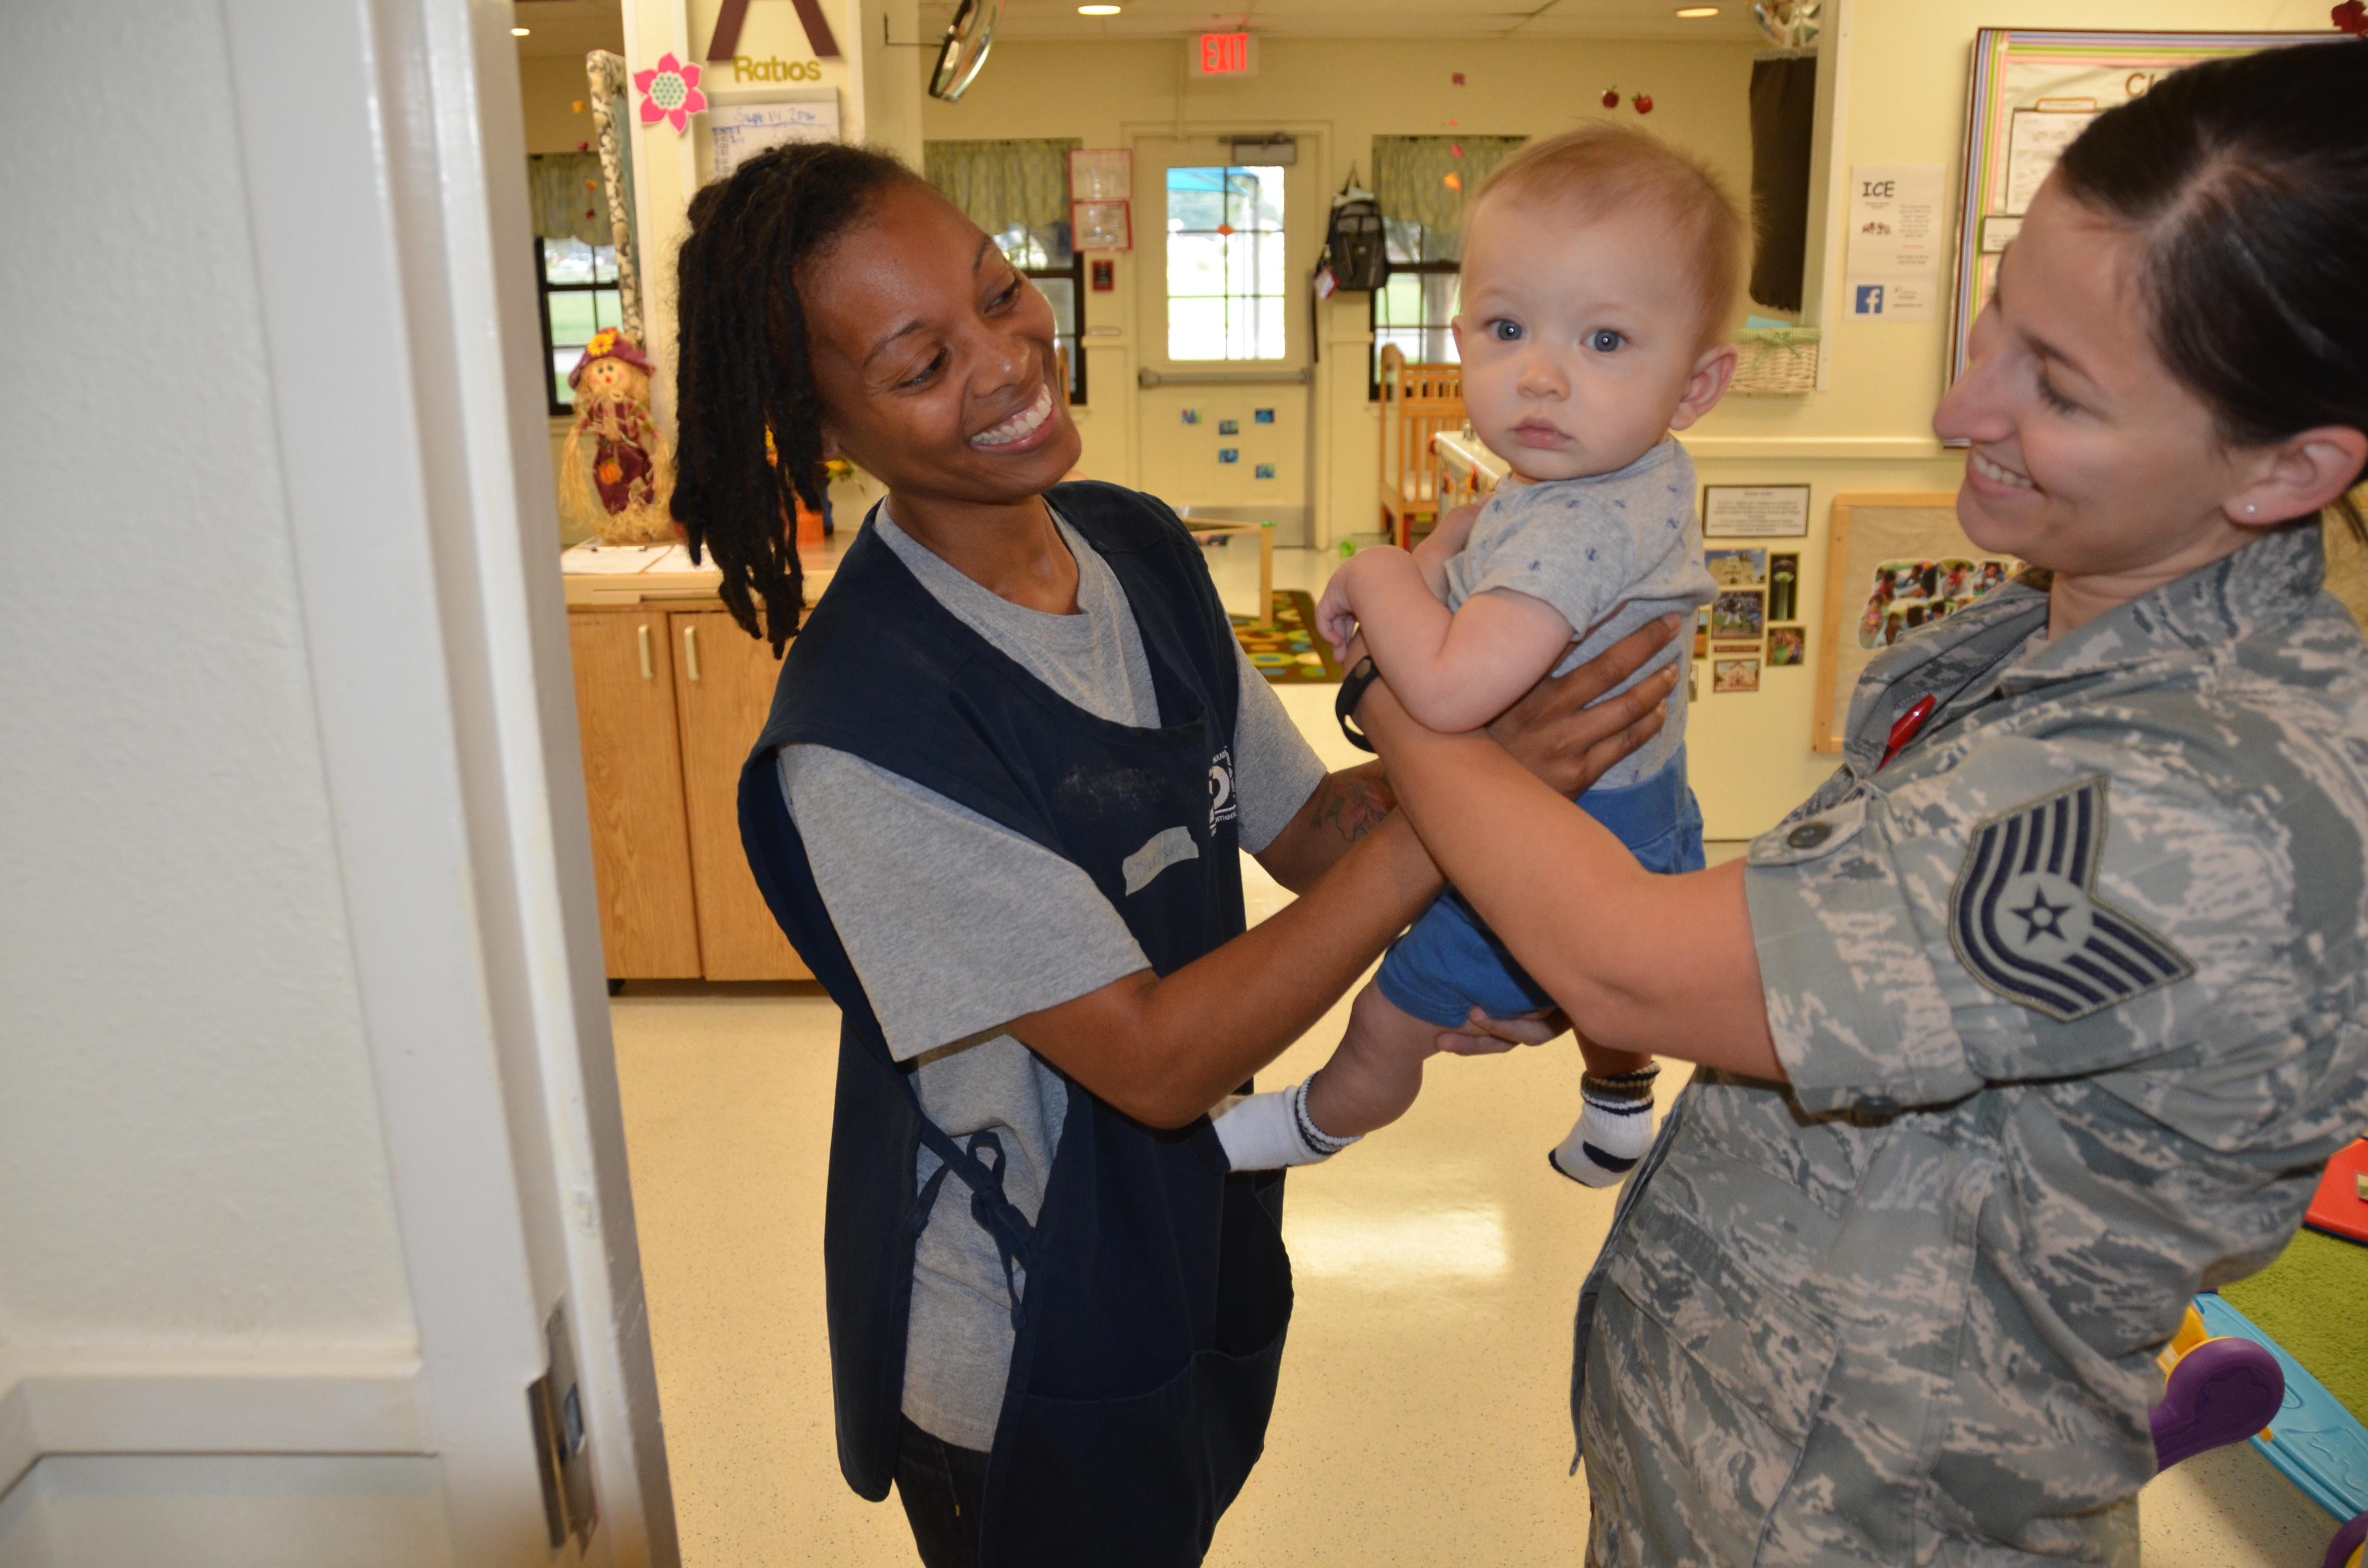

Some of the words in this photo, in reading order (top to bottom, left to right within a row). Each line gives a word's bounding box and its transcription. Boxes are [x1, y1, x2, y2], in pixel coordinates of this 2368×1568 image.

[1201, 33, 1249, 73] EXIT
[733, 55, 821, 83] Ratios
[1862, 180, 1895, 197] ICE
